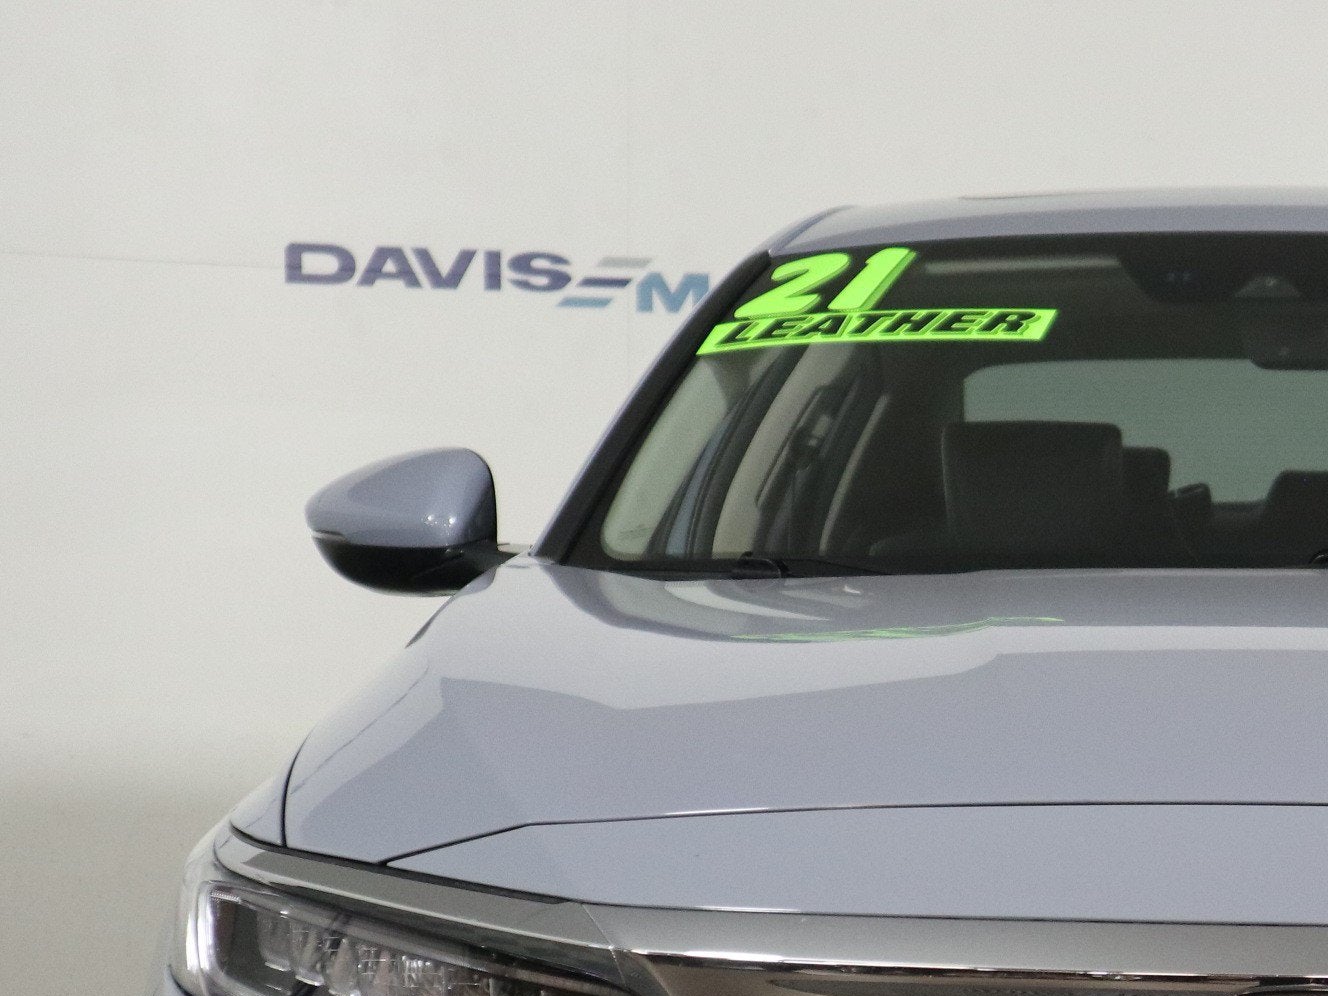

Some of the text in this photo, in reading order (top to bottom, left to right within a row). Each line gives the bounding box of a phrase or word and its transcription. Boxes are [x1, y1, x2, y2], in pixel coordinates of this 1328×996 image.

[284, 242, 572, 292] DAVIS
[734, 247, 917, 318] 21
[716, 311, 1042, 347] LEATHER
